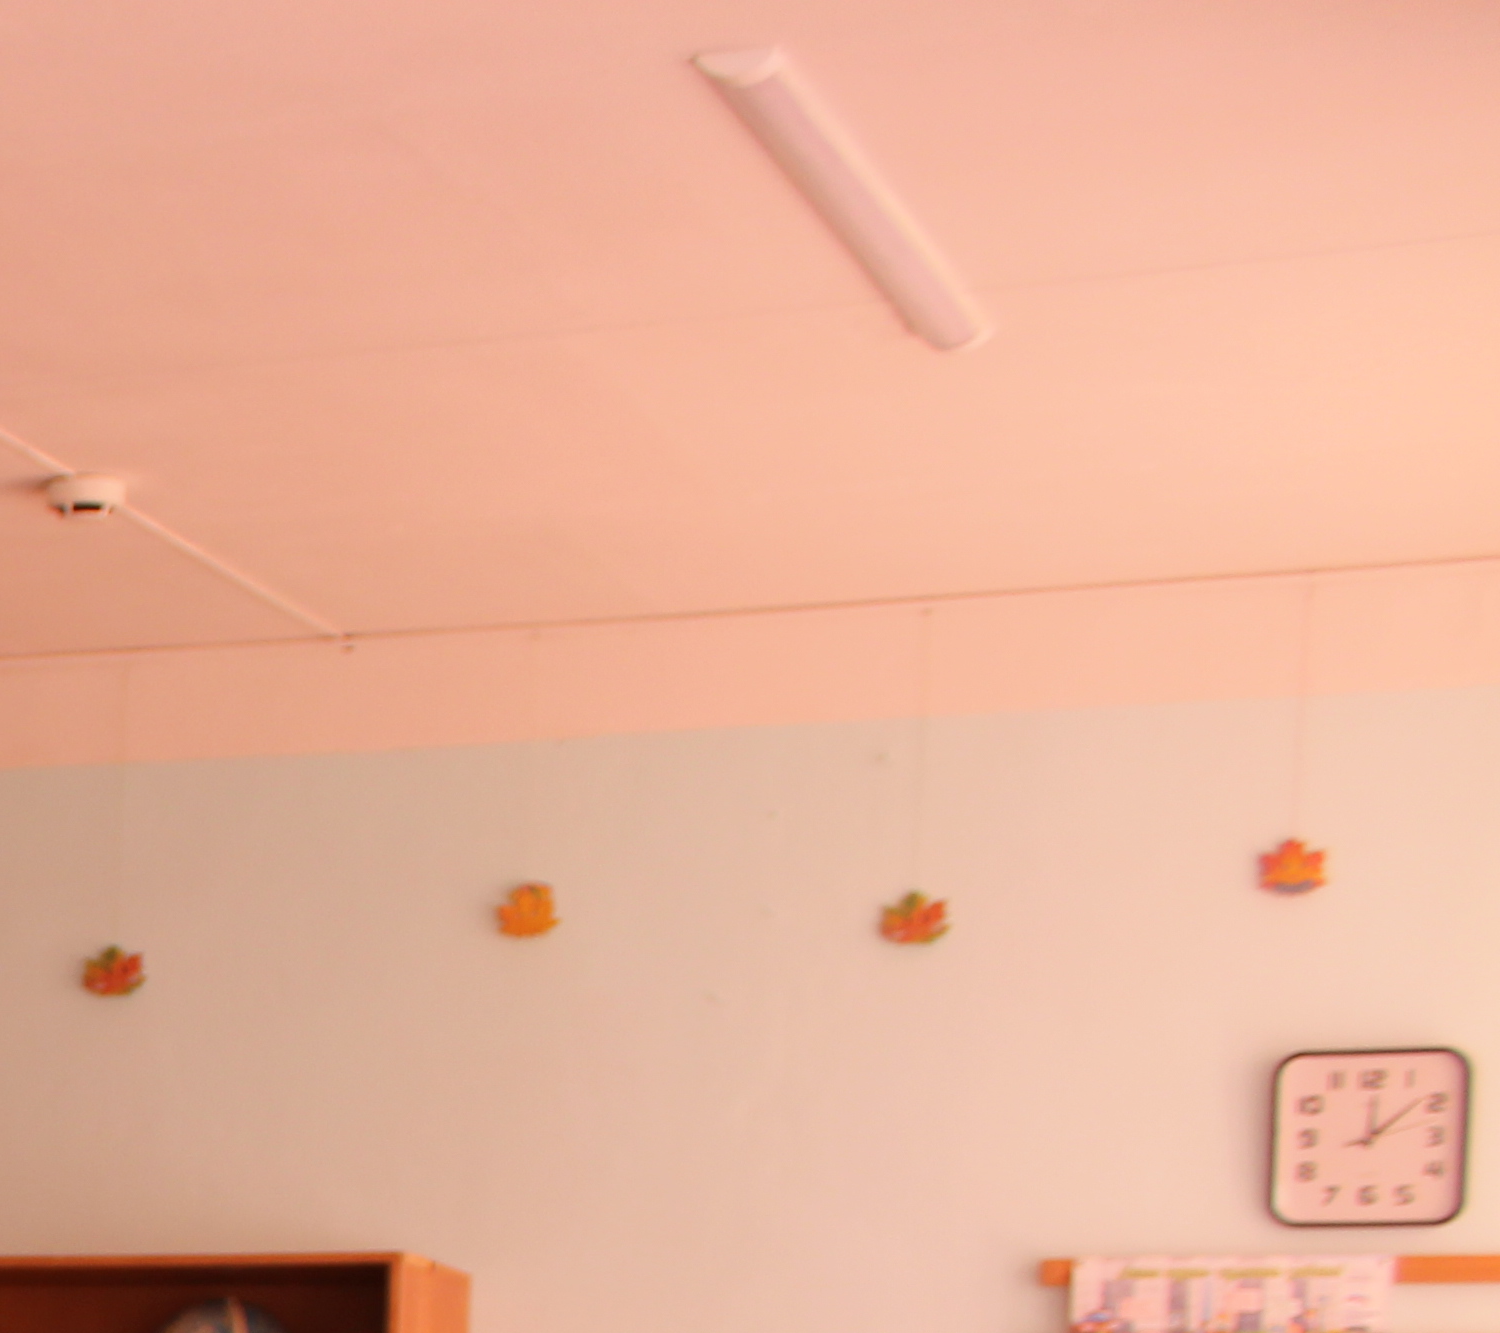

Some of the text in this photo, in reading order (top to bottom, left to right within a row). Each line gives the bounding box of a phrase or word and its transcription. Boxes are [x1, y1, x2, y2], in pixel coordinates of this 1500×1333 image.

[1357, 1069, 1388, 1090] 12
[1424, 1092, 1448, 1114] 2
[1297, 1128, 1319, 1149] 9
[1427, 1126, 1446, 1147] 3
[1295, 1161, 1318, 1183] 8
[1422, 1160, 1446, 1178] 4
[1322, 1185, 1341, 1206] 7
[1357, 1185, 1379, 1207] 6
[1394, 1184, 1416, 1207] 5
